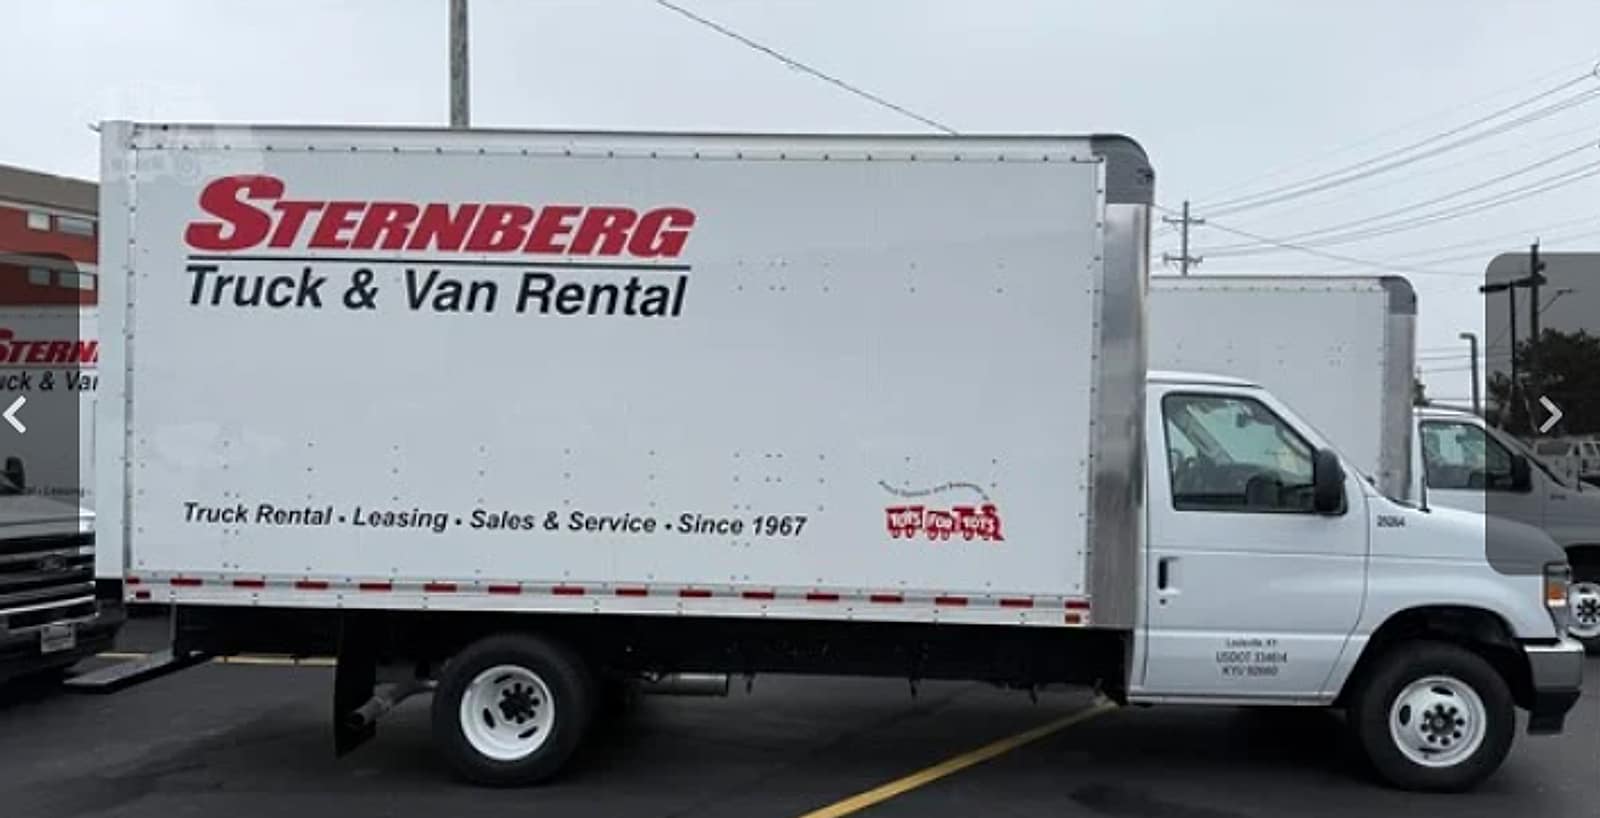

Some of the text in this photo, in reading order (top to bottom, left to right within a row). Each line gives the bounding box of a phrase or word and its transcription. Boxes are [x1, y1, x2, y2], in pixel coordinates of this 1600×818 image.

[184, 175, 695, 258] STERNBERG
[185, 265, 690, 318] Truck & Van Rental
[0, 328, 98, 363] TERN
[39, 371, 54, 391] &
[183, 501, 808, 537] Truck Rental Leasing Sales & Service Since 1967
